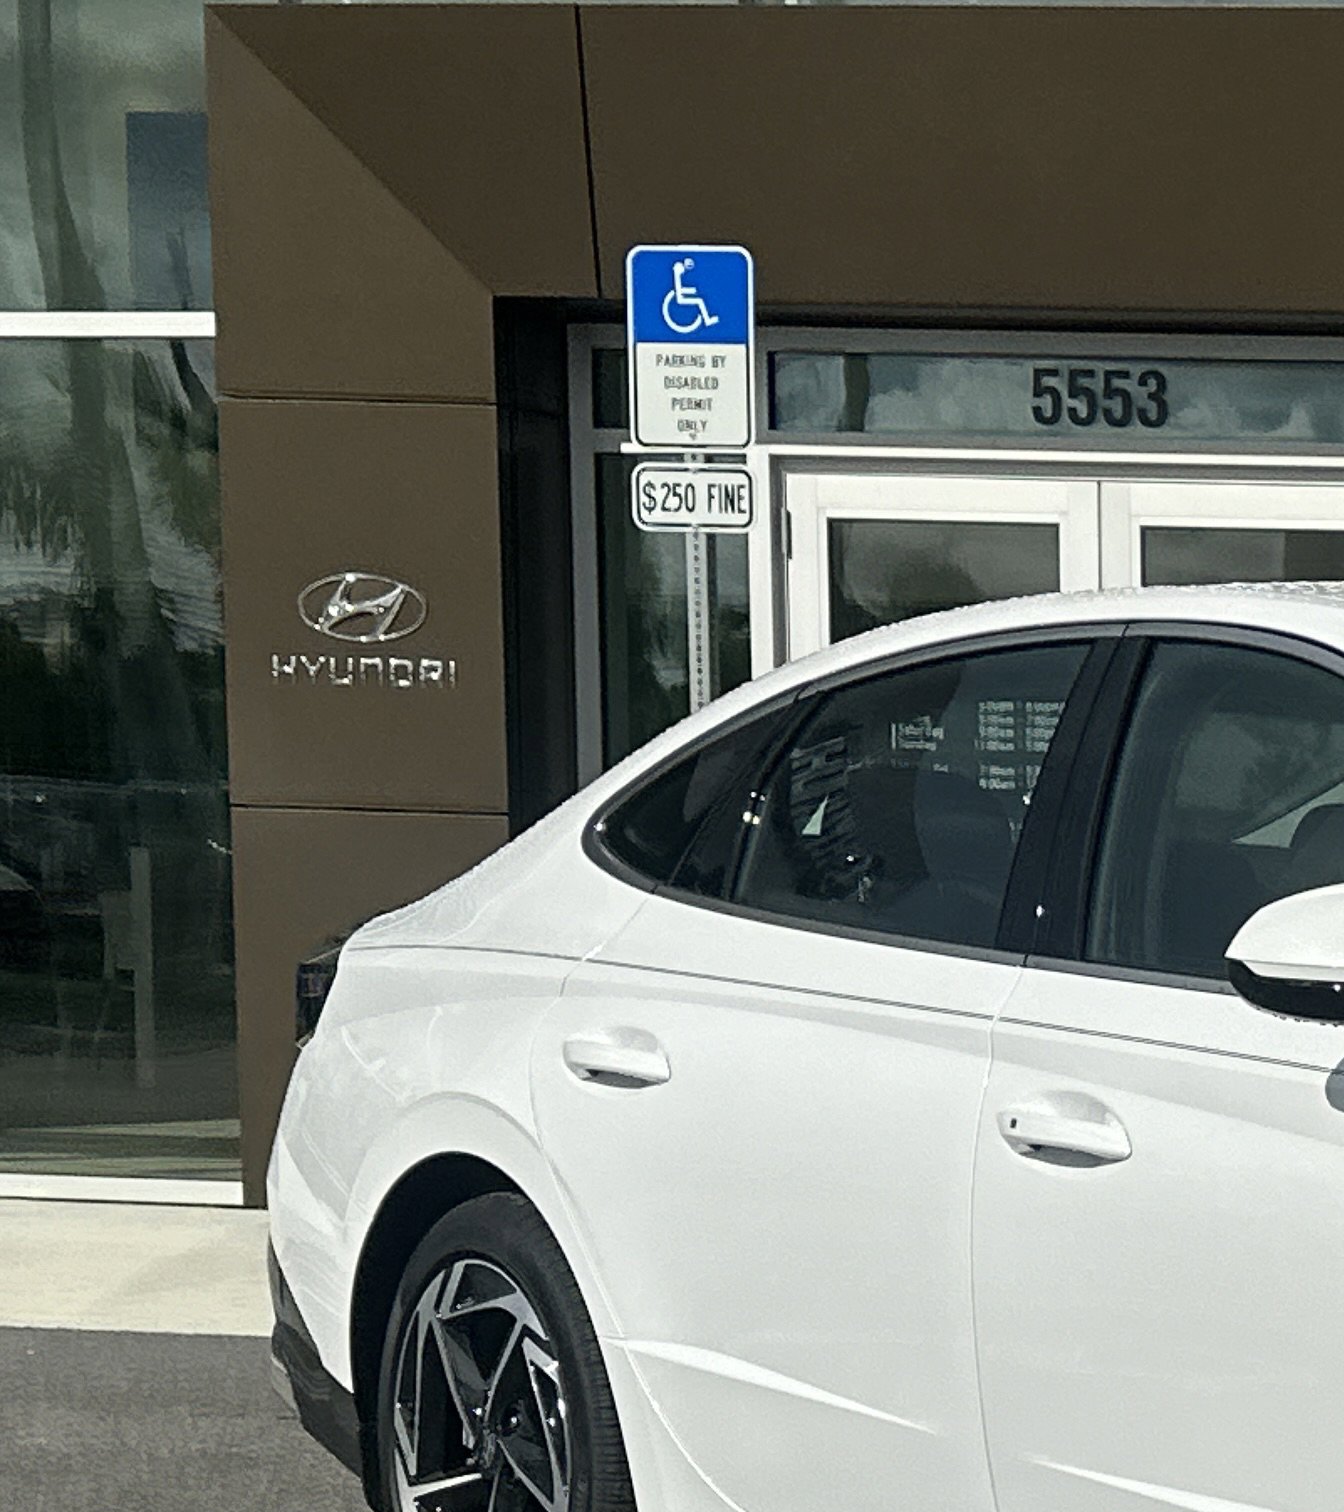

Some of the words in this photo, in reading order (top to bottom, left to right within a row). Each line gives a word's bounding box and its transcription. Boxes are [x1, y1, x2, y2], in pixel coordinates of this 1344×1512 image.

[655, 353, 706, 368] PARKING
[712, 355, 727, 368] BY
[663, 375, 719, 390] DISABLED
[671, 397, 713, 412] PERMIT
[1032, 368, 1168, 428] 5553
[677, 420, 708, 432] ONLY
[642, 480, 697, 515] $250
[707, 483, 748, 514] FINE
[271, 654, 456, 688] HYUNDAI
